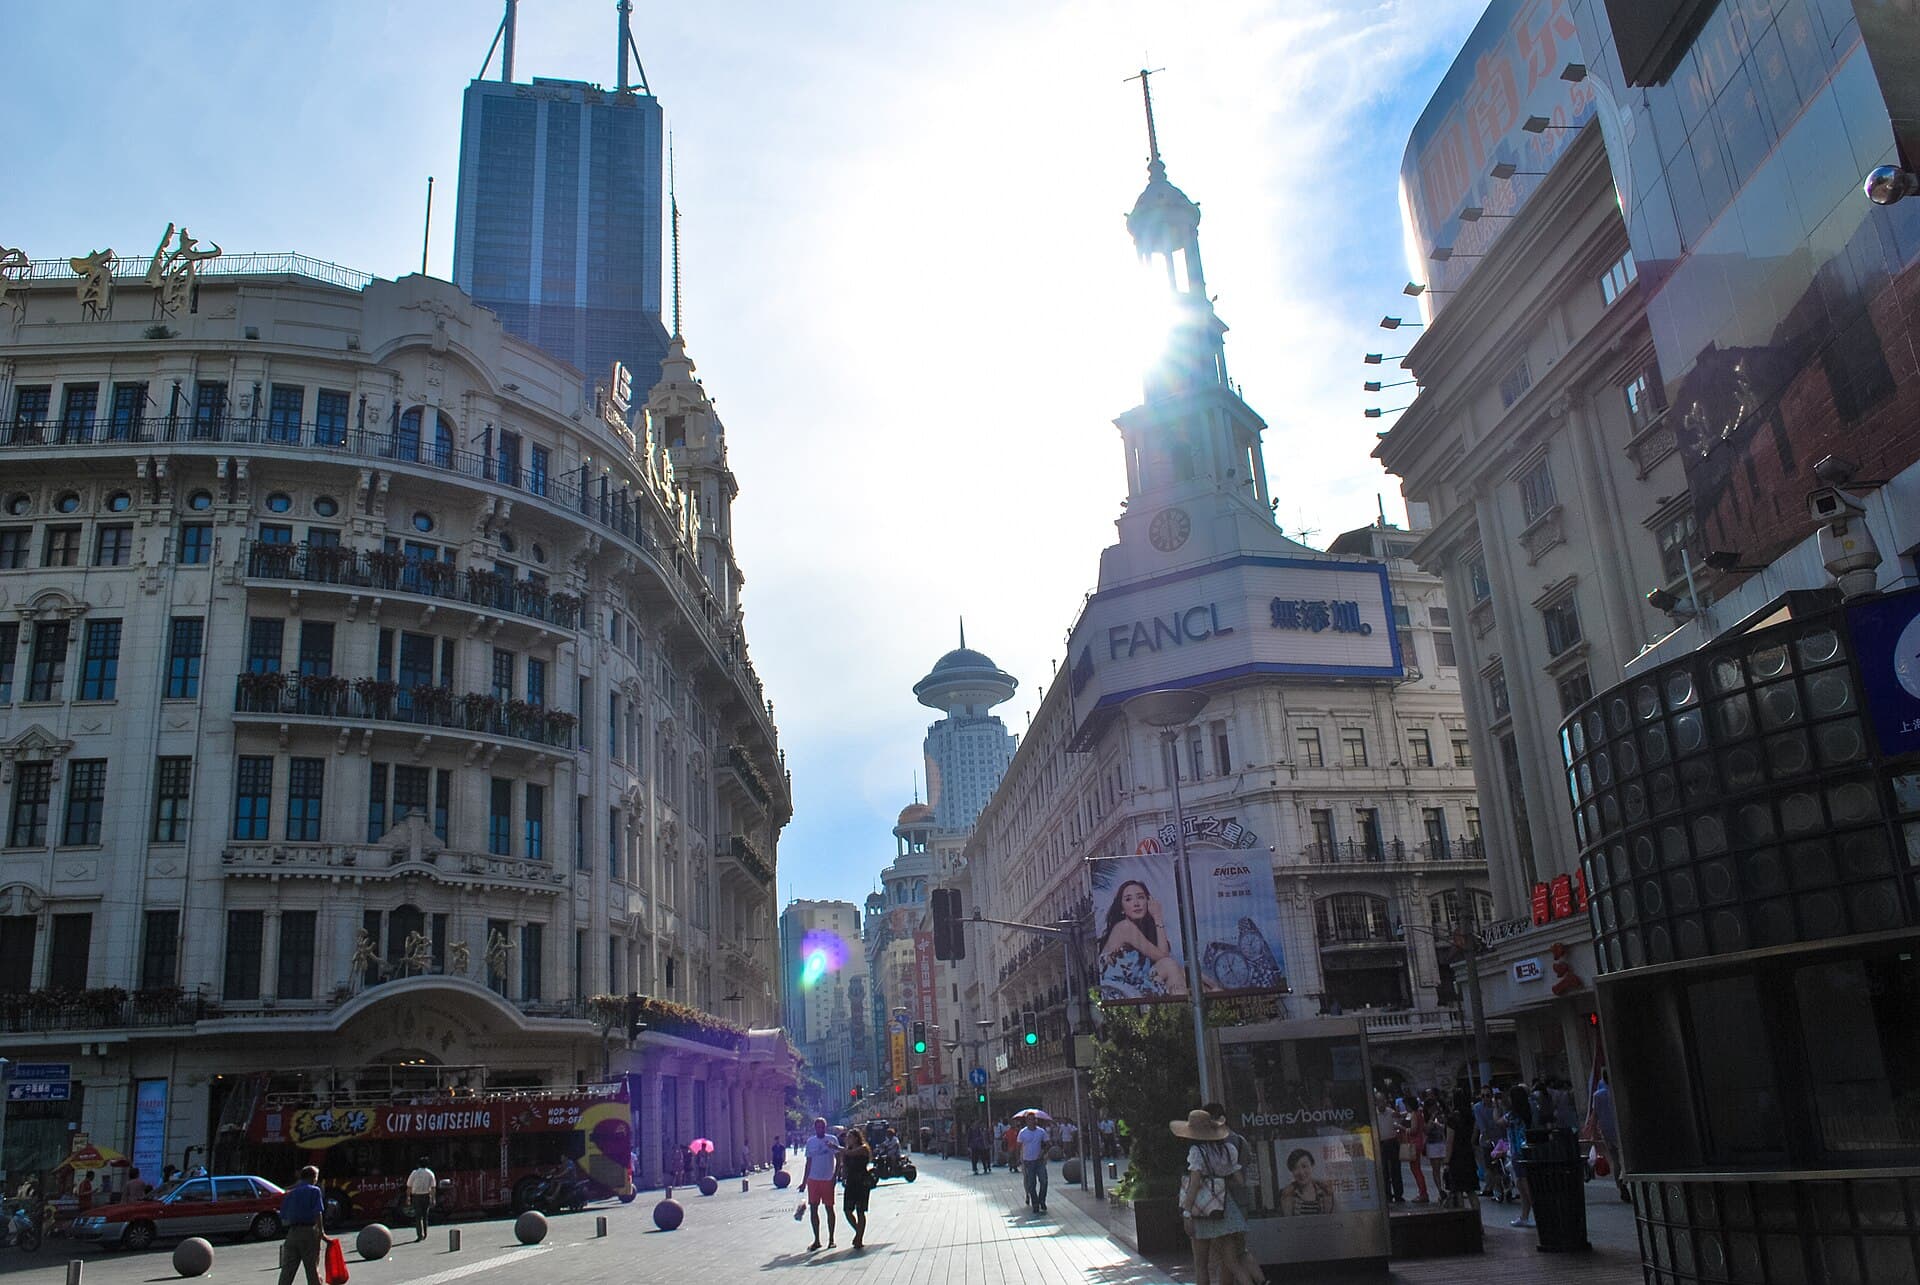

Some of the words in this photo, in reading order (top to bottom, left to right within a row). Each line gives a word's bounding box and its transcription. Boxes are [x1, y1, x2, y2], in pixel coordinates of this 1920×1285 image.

[1108, 602, 1233, 660] FANCL
[1213, 866, 1251, 877] ENICAR
[547, 1107, 579, 1116] HOP-ON
[1241, 1108, 1354, 1128] Meters/bonwe
[386, 1112, 411, 1133] CITY
[415, 1110, 490, 1131] SIGHTSEEING
[547, 1116, 583, 1125] HOP-OFF
